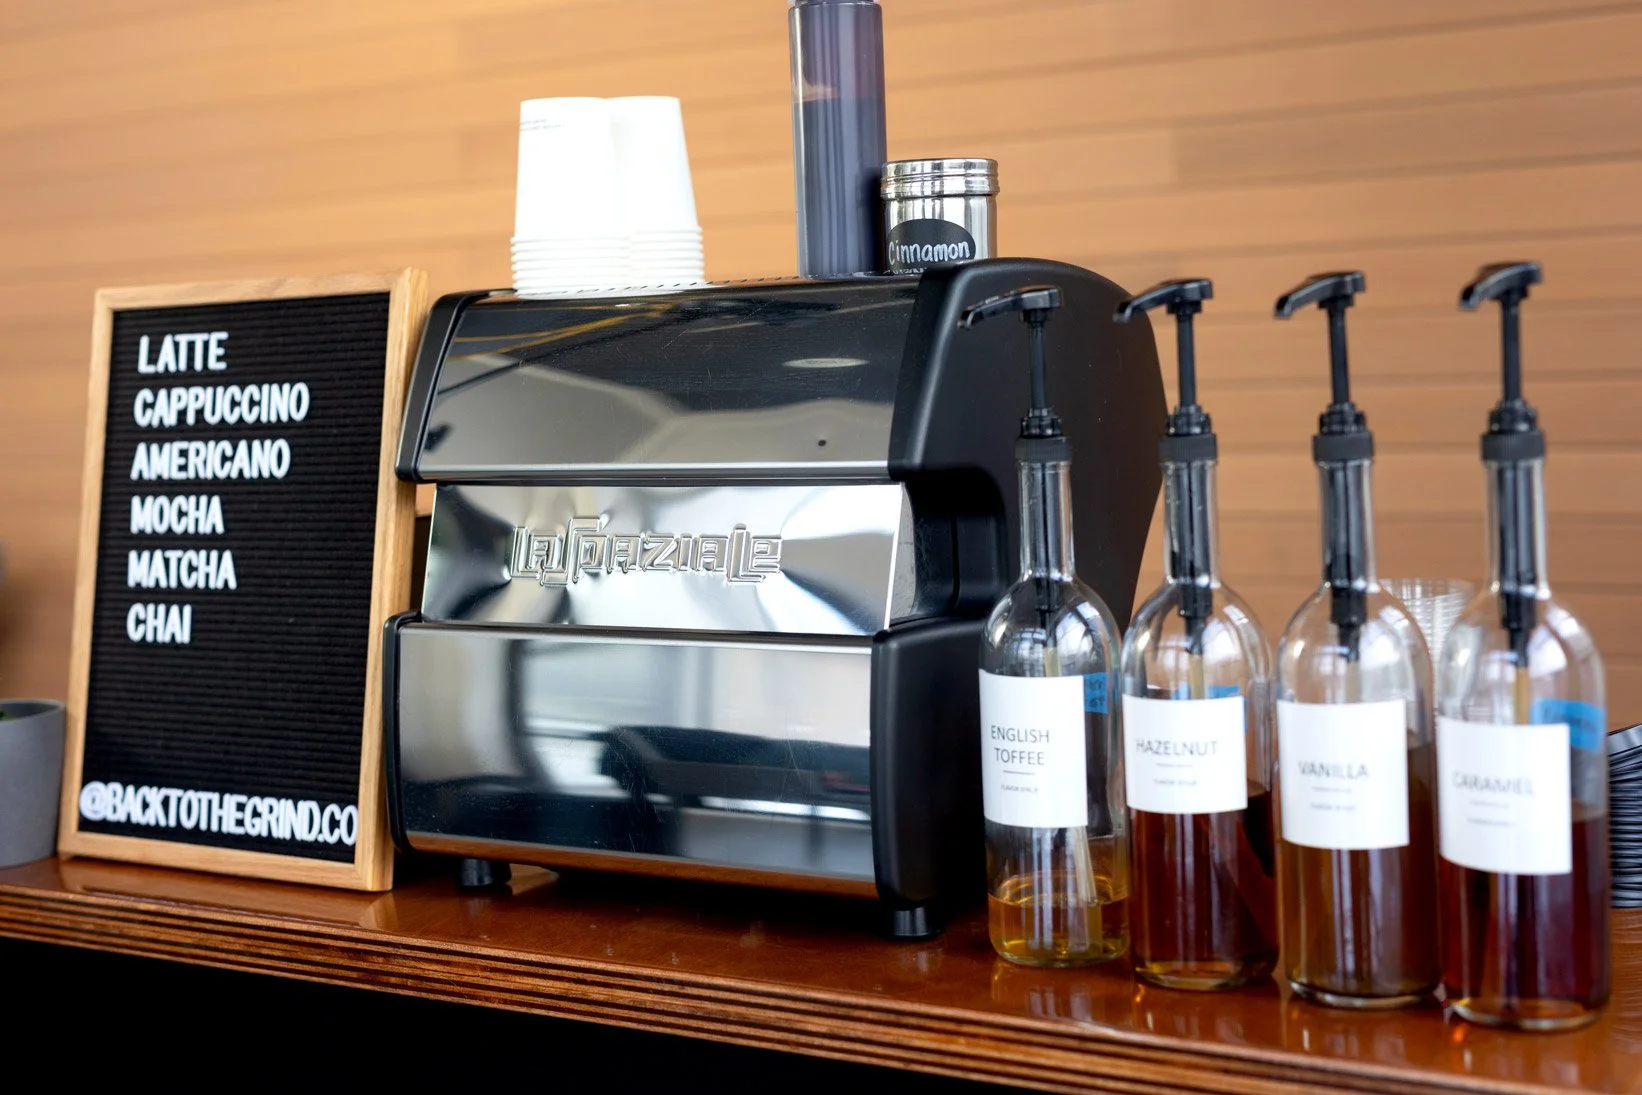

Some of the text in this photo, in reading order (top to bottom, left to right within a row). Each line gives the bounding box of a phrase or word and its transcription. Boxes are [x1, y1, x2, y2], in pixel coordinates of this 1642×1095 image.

[888, 240, 971, 265] Cinnamon
[138, 332, 228, 373] LATTE
[134, 383, 309, 427] CAPPUCCINO
[131, 439, 290, 480] AMERICANO
[131, 495, 224, 534] MOCHA
[128, 549, 236, 589] MATCHA
[127, 603, 191, 643] CHAI
[991, 725, 1050, 744] ENGLISH
[1135, 738, 1217, 757] HAZELNUT
[994, 747, 1045, 766] TOFFEE
[79, 781, 357, 846] @BACKTOTHEGRIND.CO
